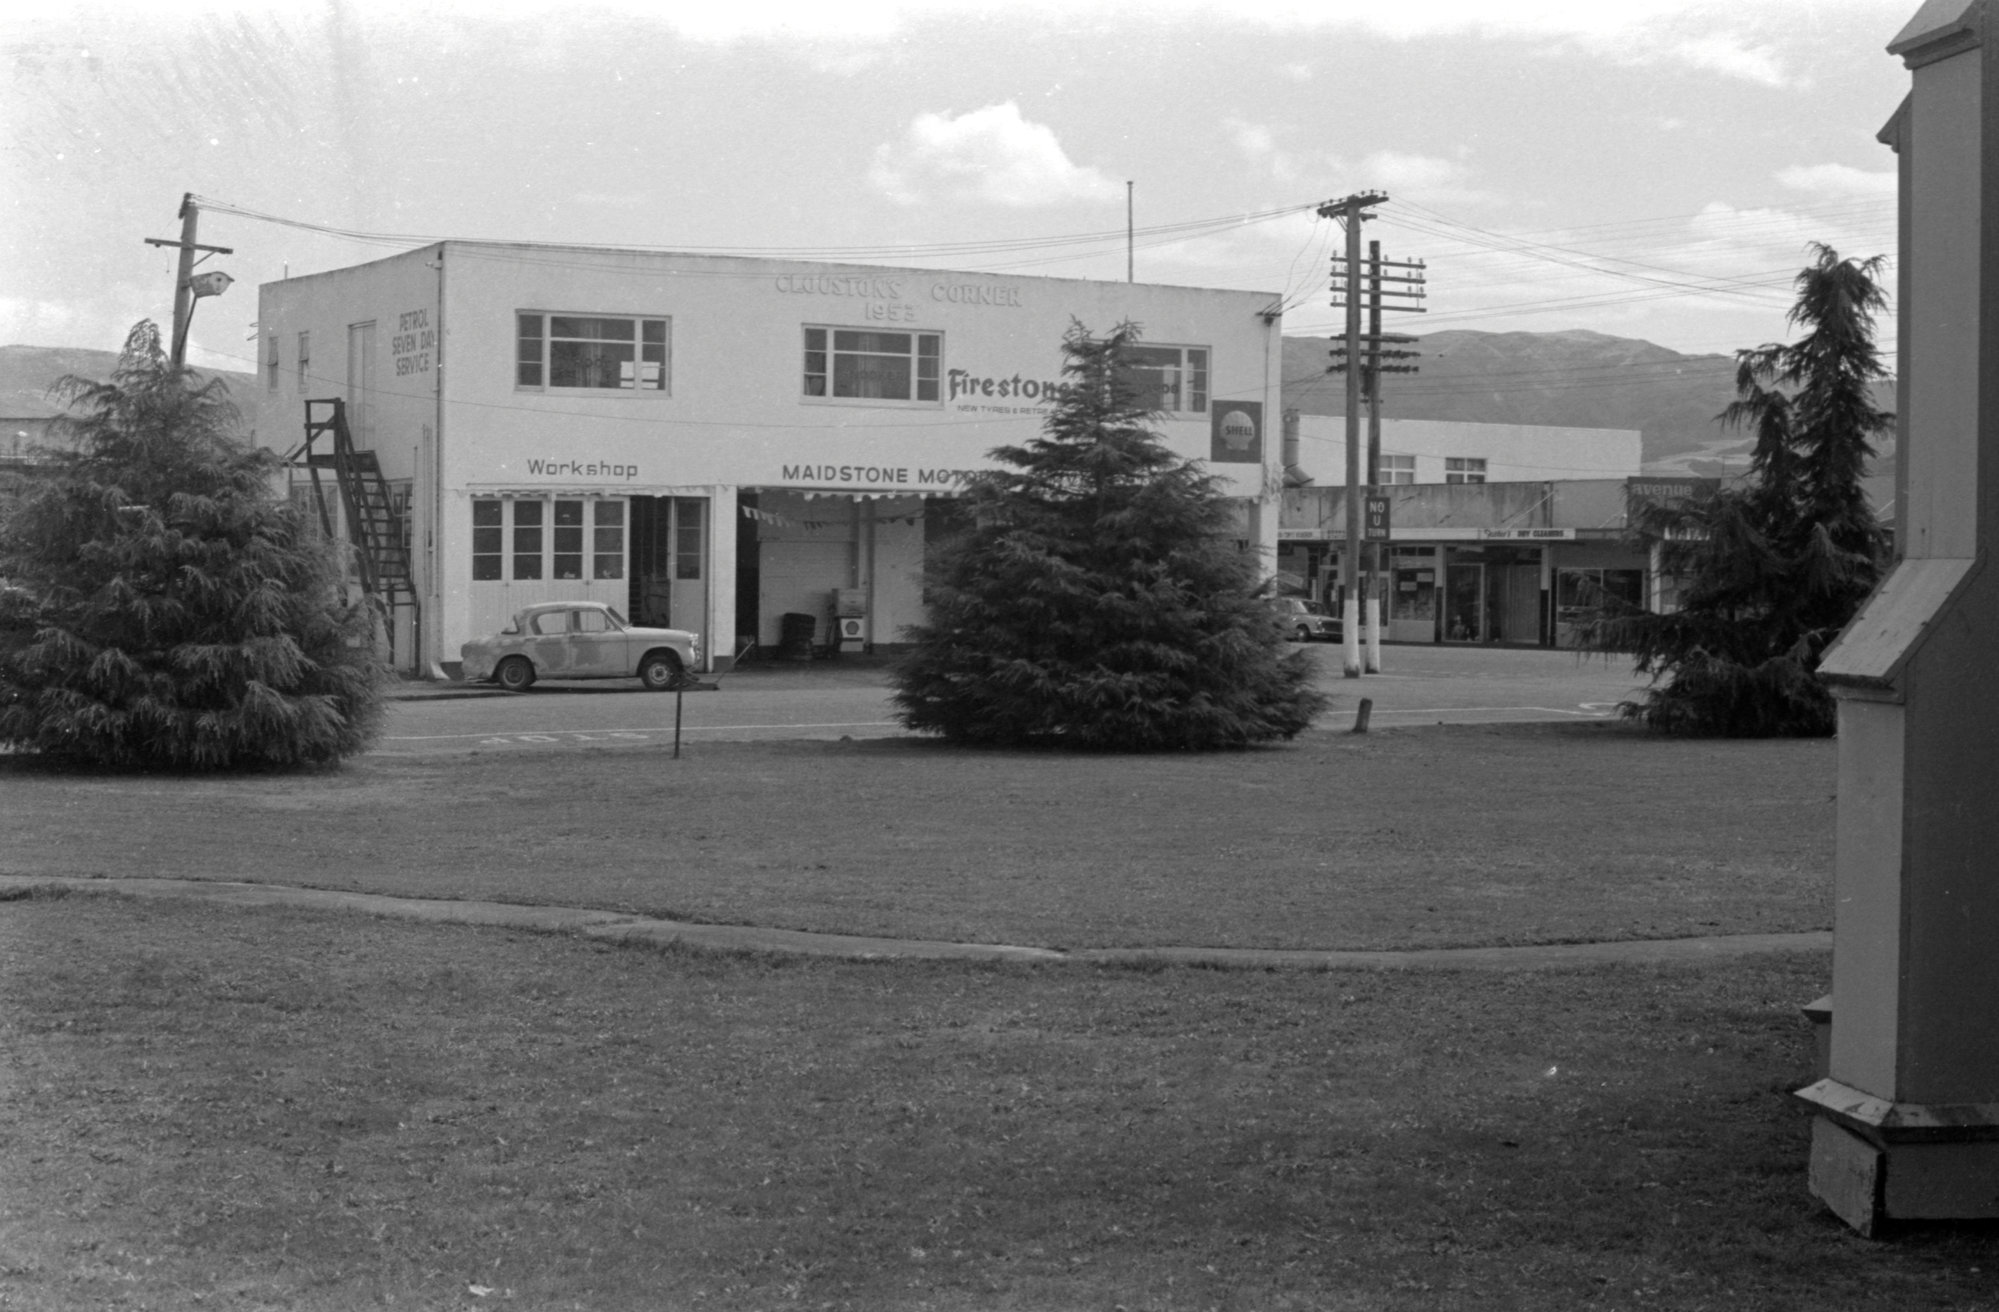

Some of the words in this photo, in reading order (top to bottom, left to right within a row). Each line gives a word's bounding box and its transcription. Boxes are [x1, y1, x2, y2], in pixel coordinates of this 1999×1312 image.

[931, 282, 1023, 308] CORNER
[399, 307, 429, 332] PETROL
[392, 333, 417, 355] SEVEN
[420, 329, 436, 350] DAY
[396, 352, 430, 376] SERVICE
[947, 368, 1071, 402] Firestone
[981, 406, 1010, 414] TYRES
[1225, 425, 1252, 436] SHELL
[527, 459, 639, 480] Workshop
[782, 464, 909, 483] MAIDSTONE
[1630, 483, 1692, 496] avenue
[1369, 501, 1385, 513] NO
[1373, 515, 1382, 526] U
[1368, 528, 1386, 537] TURN
